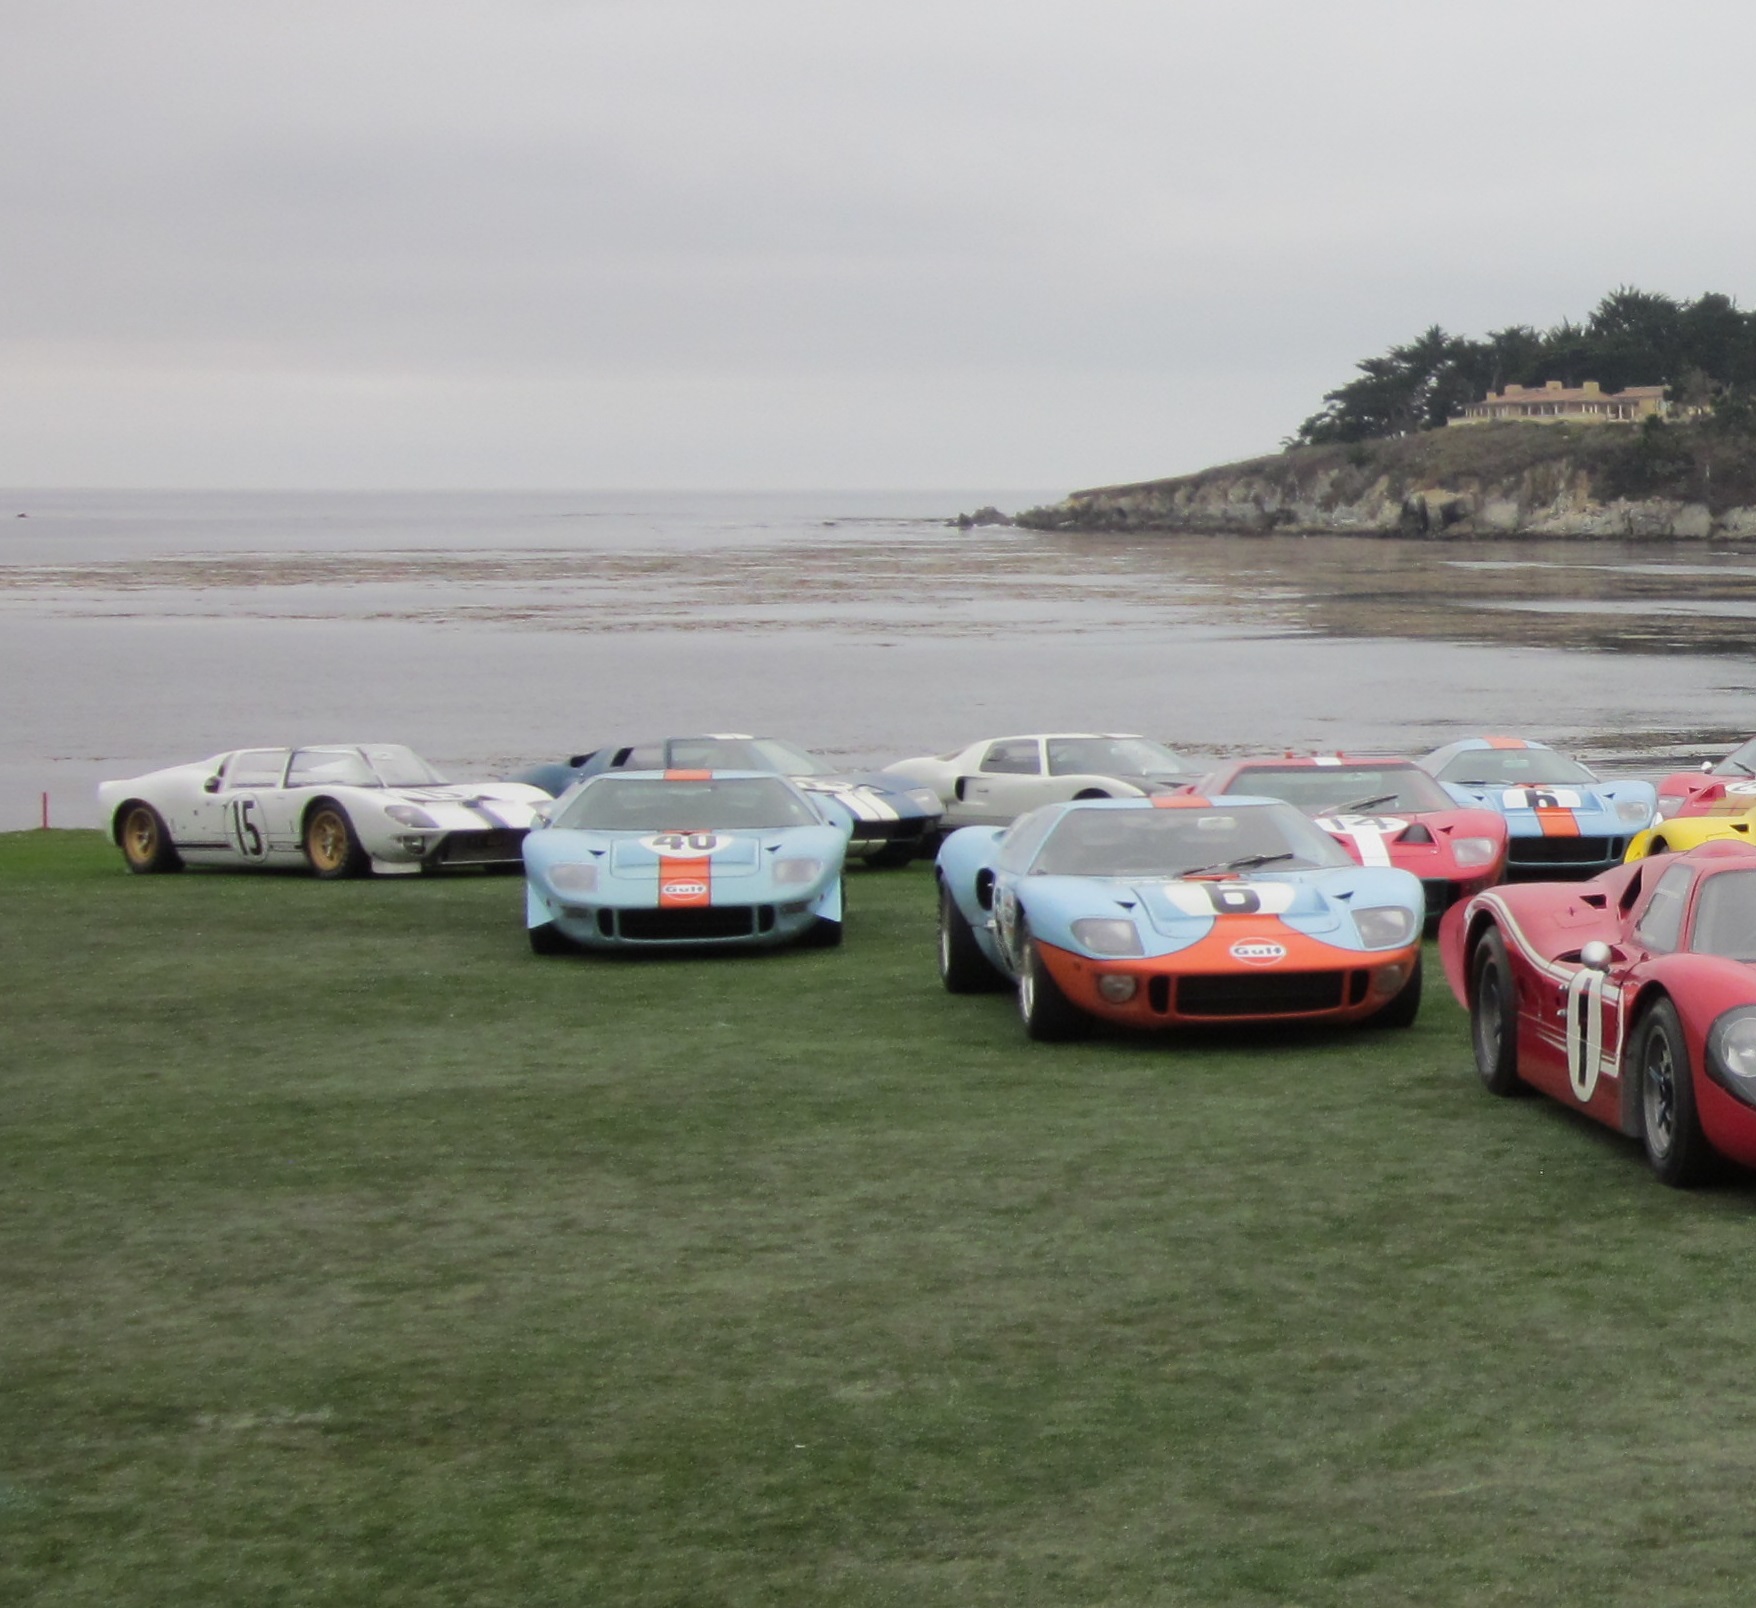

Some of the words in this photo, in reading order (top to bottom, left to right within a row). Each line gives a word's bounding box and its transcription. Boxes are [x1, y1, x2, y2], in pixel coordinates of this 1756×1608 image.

[1524, 789, 1559, 808] 6
[233, 800, 263, 856] 15
[1330, 816, 1393, 830] 14
[652, 835, 717, 850] 40
[1200, 882, 1261, 914] 6
[1233, 946, 1283, 956] Gulf
[1577, 976, 1593, 1087] 1
